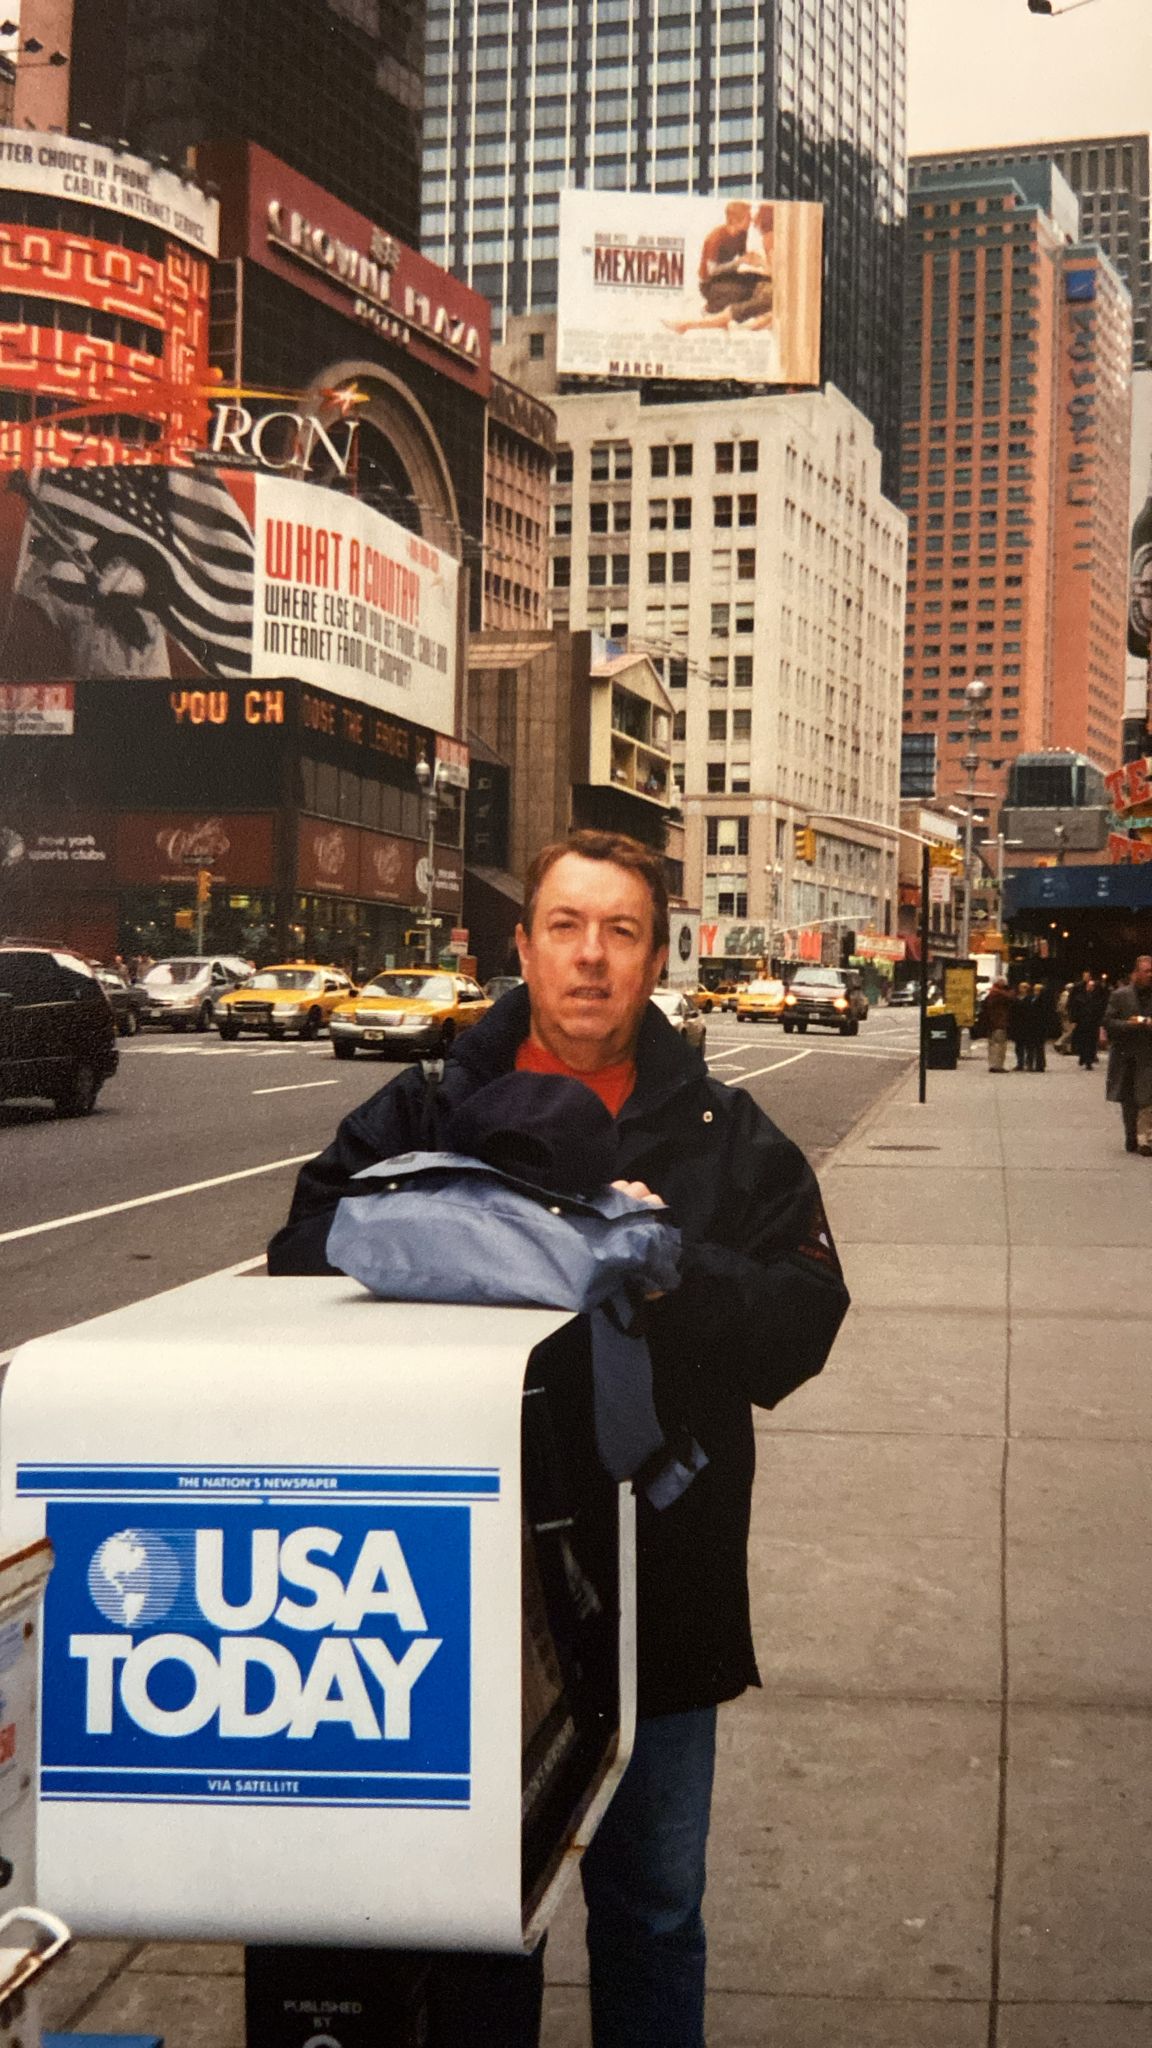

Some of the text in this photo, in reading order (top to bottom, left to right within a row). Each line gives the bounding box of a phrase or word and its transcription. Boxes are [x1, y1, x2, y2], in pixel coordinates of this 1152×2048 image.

[38, 147, 88, 174] CHOICE
[93, 159, 107, 179] IN
[63, 174, 104, 201] CABLE
[594, 247, 684, 286] MEXICAN
[609, 361, 664, 376] MARCH
[212, 403, 360, 477] RCN
[265, 518, 343, 591] WHAT
[350, 538, 360, 598] A
[264, 583, 318, 624] WHERE
[323, 594, 350, 630] ELSE
[264, 620, 333, 663] INTERNET
[337, 633, 363, 670] FROM
[169, 690, 228, 724] YOU
[178, 1476, 338, 1489] THE NATION'S NEWSPAPER
[195, 1526, 428, 1632] USA
[69, 1633, 443, 1741] TODAY
[207, 1779, 299, 1793] VIA SATELLITE
[283, 2000, 362, 2014] PUBLISHED
[313, 2016, 332, 2028] BY
